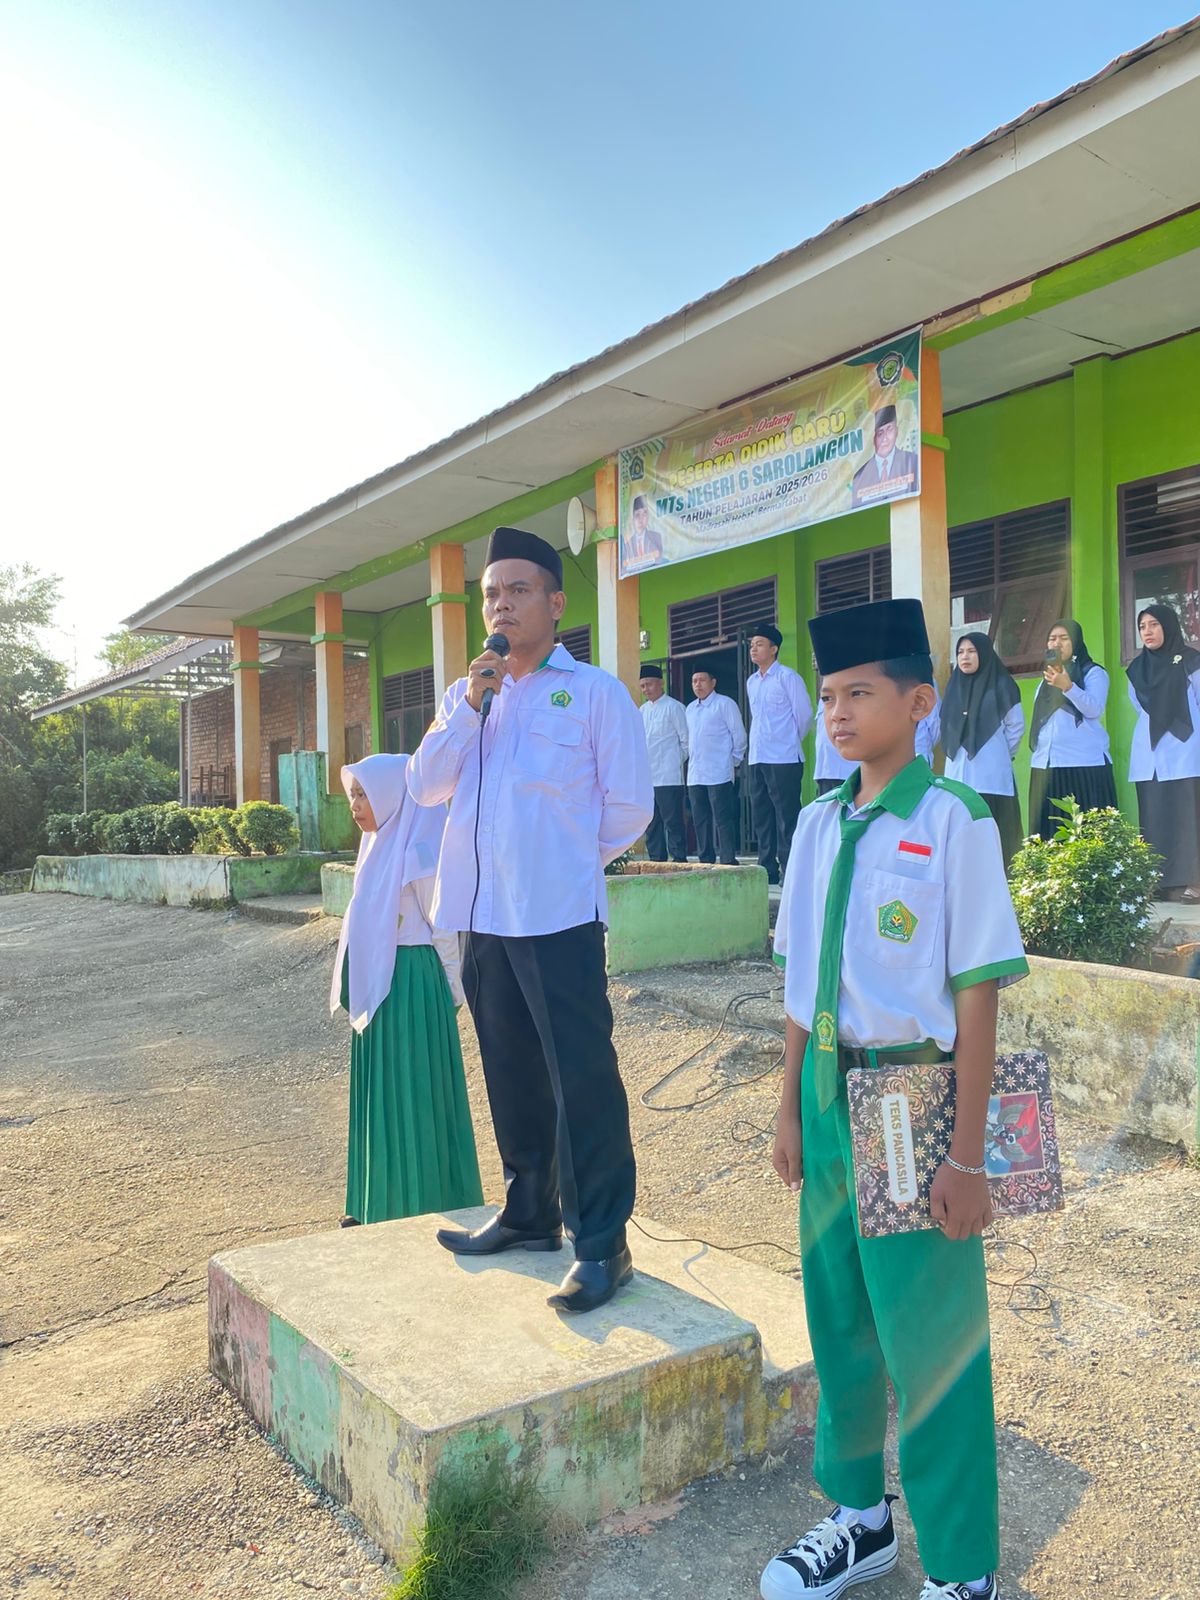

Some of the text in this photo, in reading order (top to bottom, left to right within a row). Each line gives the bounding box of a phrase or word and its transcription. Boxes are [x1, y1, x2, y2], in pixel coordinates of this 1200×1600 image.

[669, 410, 846, 490] PESERTA DIDIK BARU
[756, 411, 795, 432] Datang
[680, 508, 713, 524] TAHUN
[715, 488, 773, 515] PELAJARAN
[775, 469, 829, 497] 2025/2026
[687, 474, 736, 509] NEGERI
[738, 470, 749, 491] 6
[751, 429, 864, 487] SAROLANGUN
[758, 493, 808, 514] Bermartabat
[889, 1099, 909, 1196] TEKS PANCASILA
